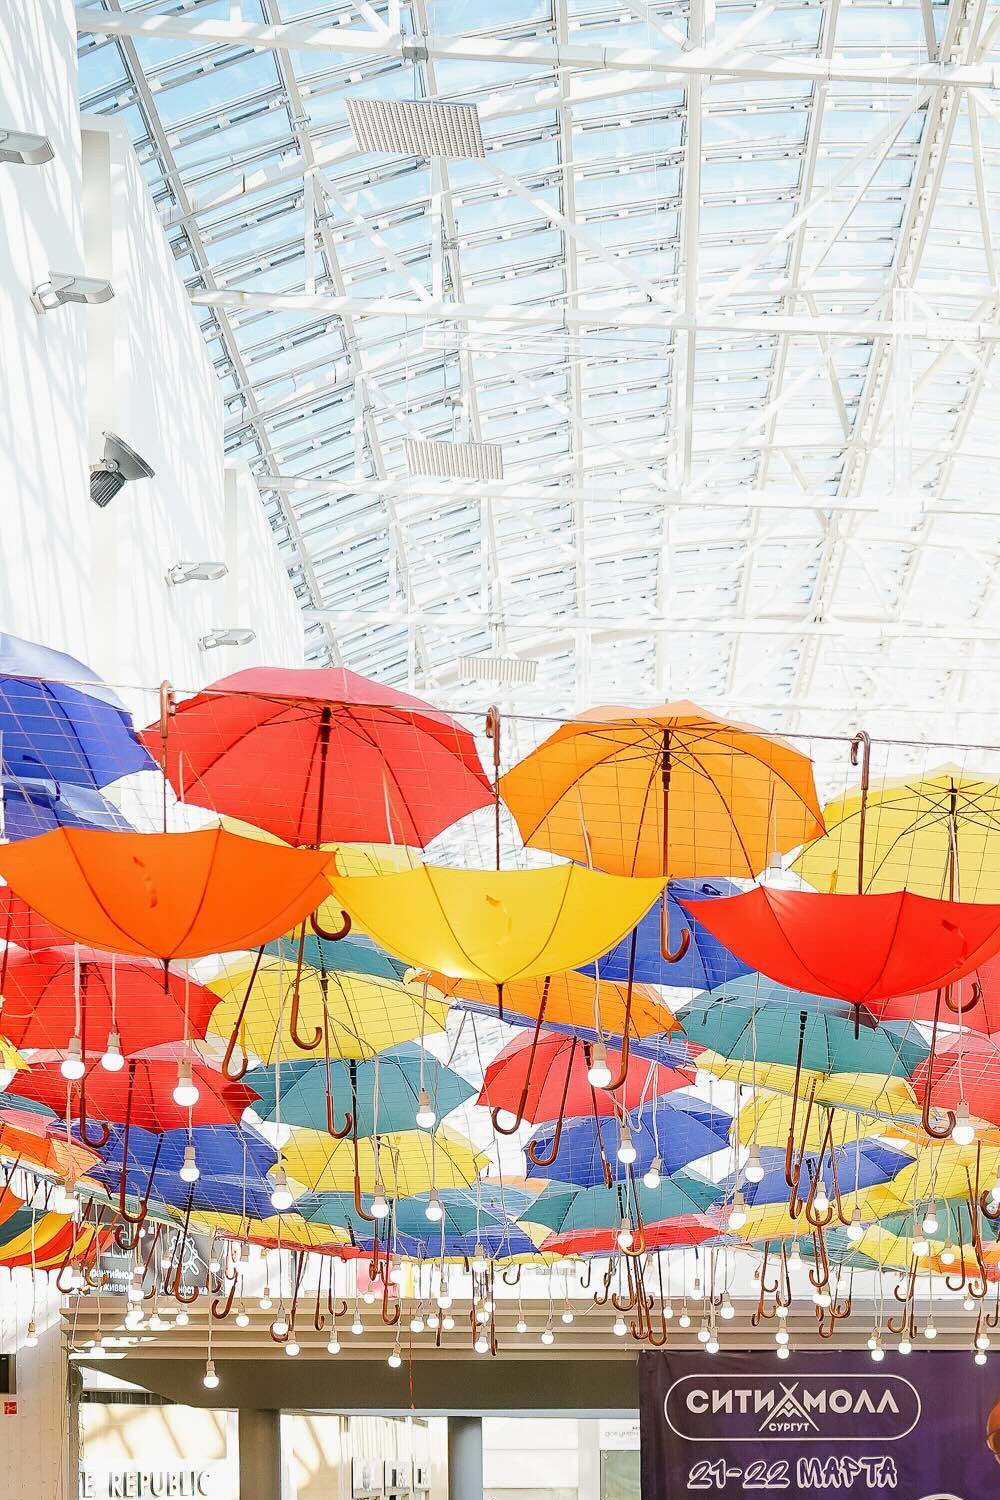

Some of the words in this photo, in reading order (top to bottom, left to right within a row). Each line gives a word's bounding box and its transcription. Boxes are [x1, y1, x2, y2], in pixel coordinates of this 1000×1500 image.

[686, 1389, 776, 1415] СИТИ
[805, 1388, 900, 1414] МОЛЛ
[768, 1421, 810, 1433] СУРГУТ
[108, 1471, 211, 1498] REPUBLIC
[687, 1460, 791, 1490] 21-22
[796, 1456, 898, 1489] МАРТА
